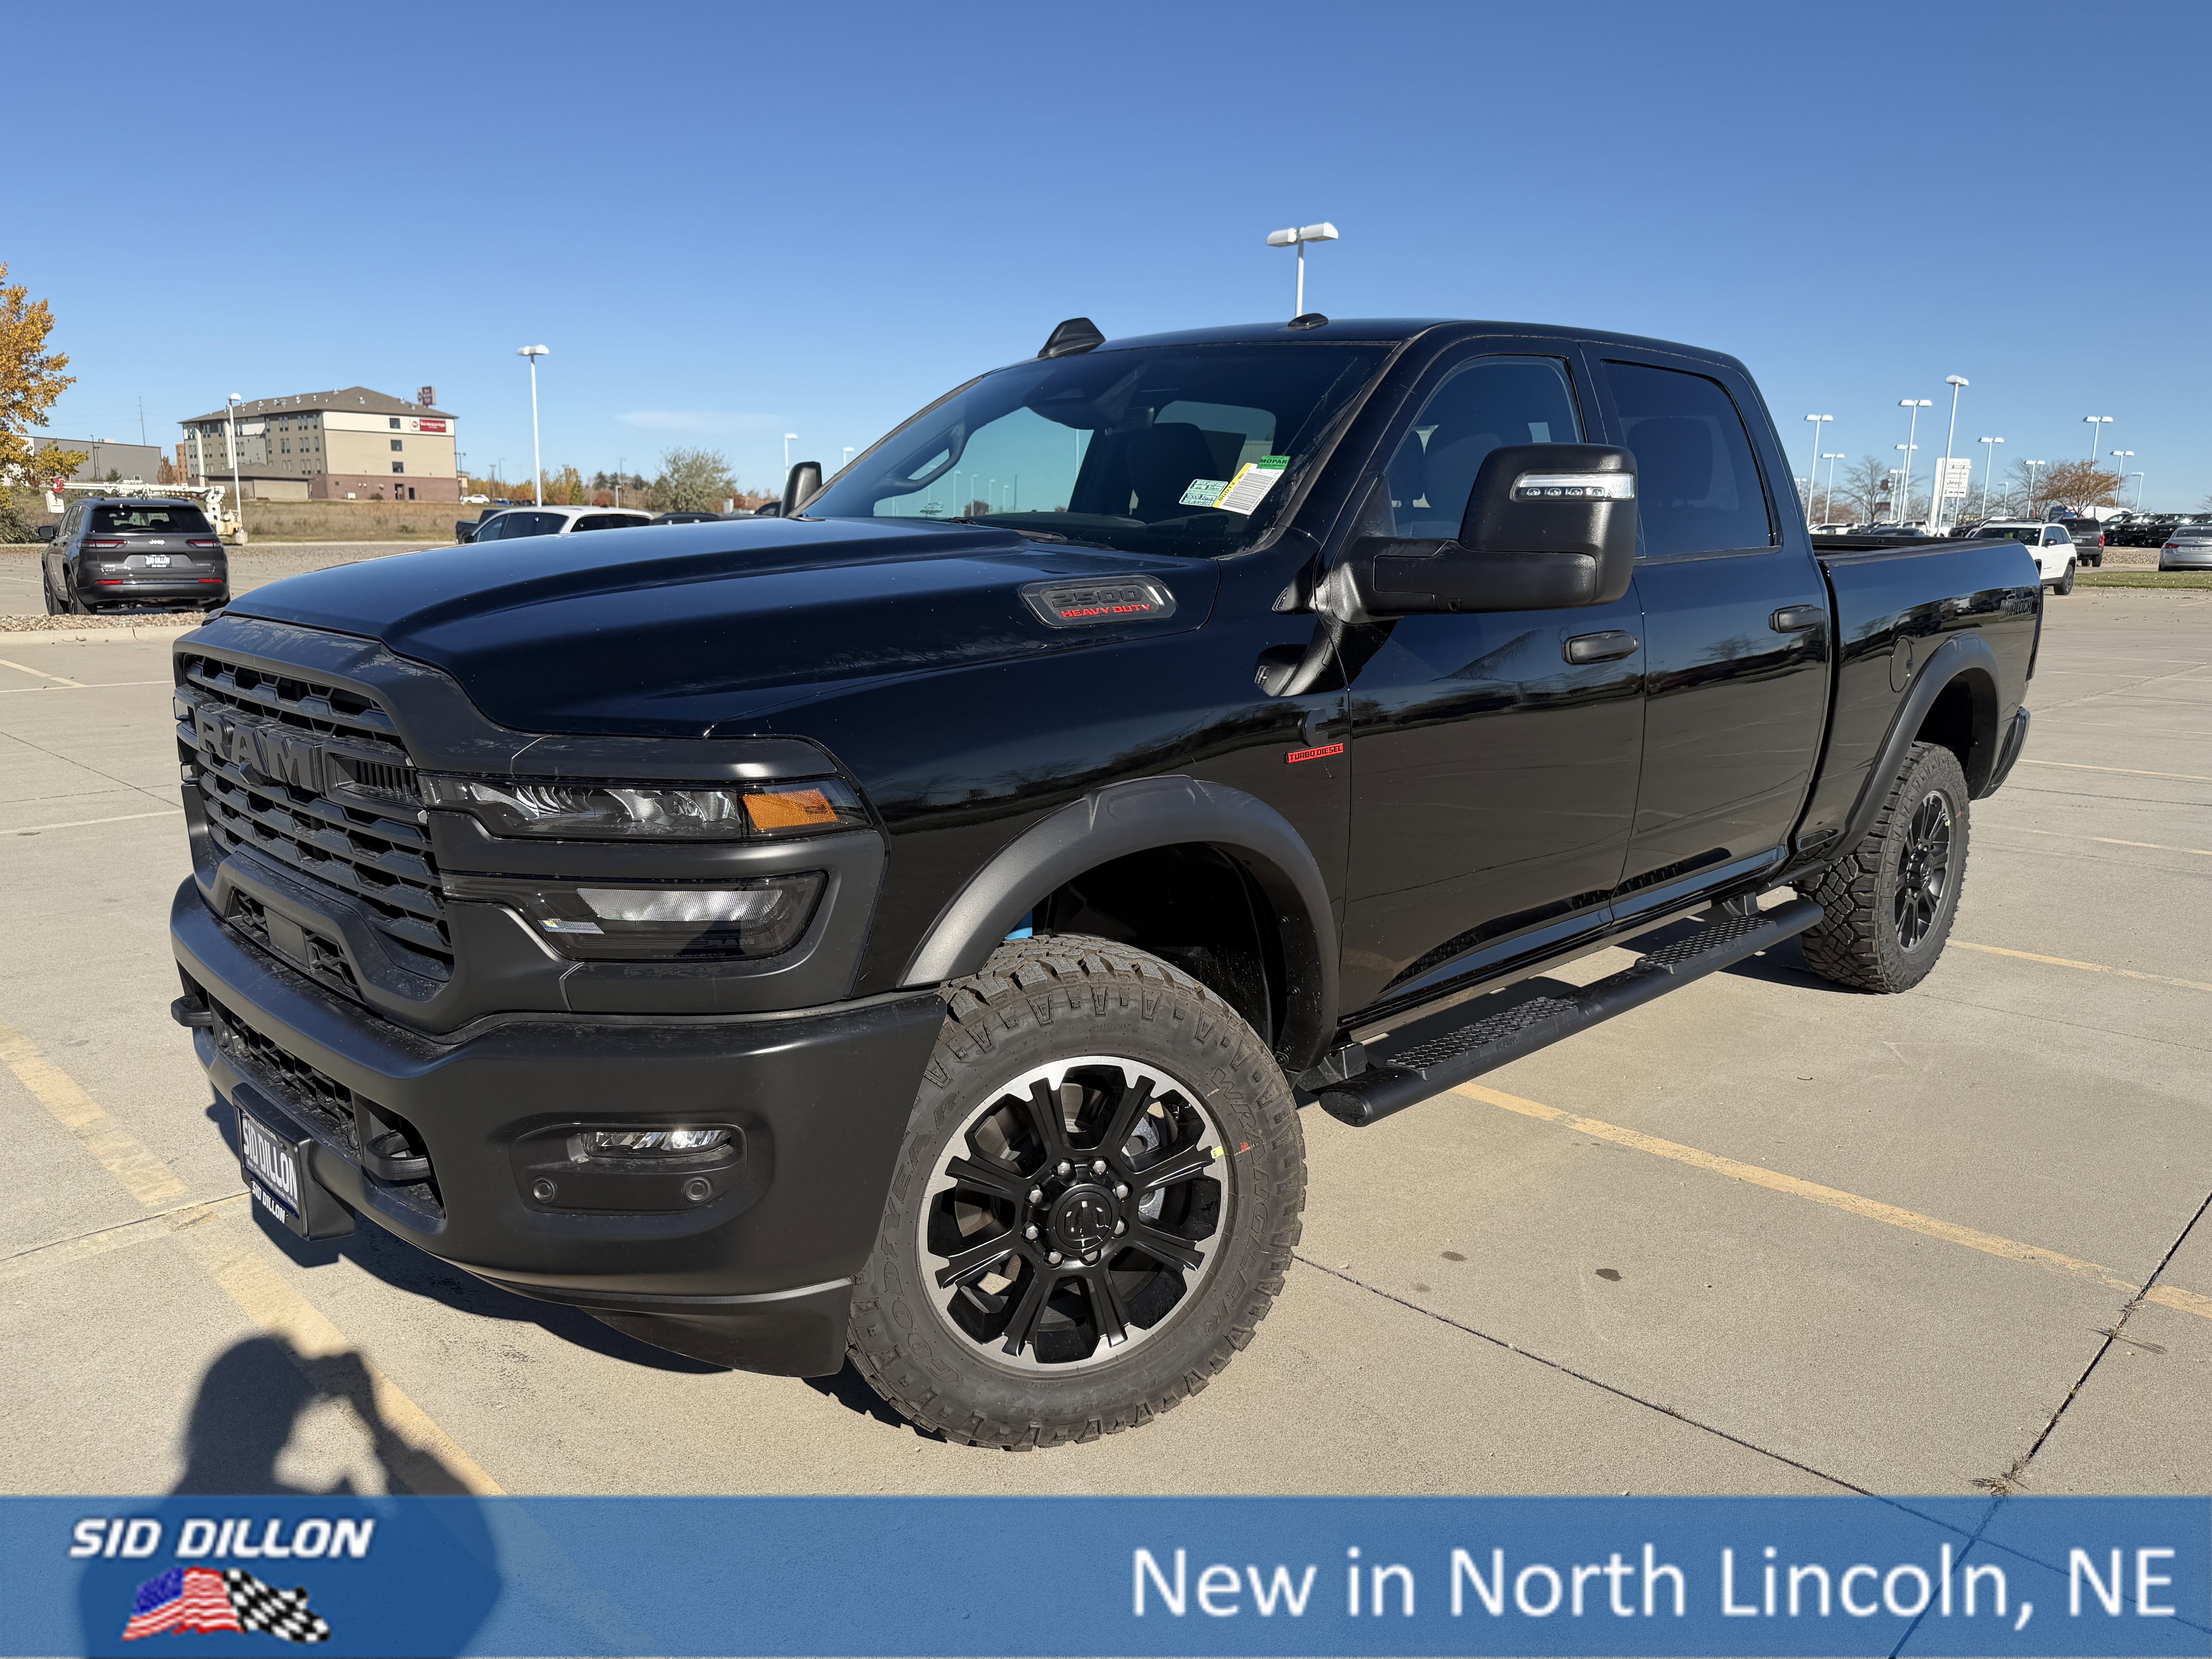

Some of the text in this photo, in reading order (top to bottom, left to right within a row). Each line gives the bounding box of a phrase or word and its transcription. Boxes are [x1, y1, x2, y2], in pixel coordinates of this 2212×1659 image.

[1050, 588, 1143, 608] 2500
[1061, 603, 1151, 618] HEAVY DUTY
[196, 708, 323, 792] RAM
[1289, 745, 1343, 761] TURBO DIESEL
[242, 1118, 258, 1165] SID
[258, 1133, 298, 1201] DILLON
[251, 1181, 286, 1224] SID DILLON
[1205, 1066, 1269, 1333] WRANGLER
[880, 1092, 959, 1382] GOODYEAR
